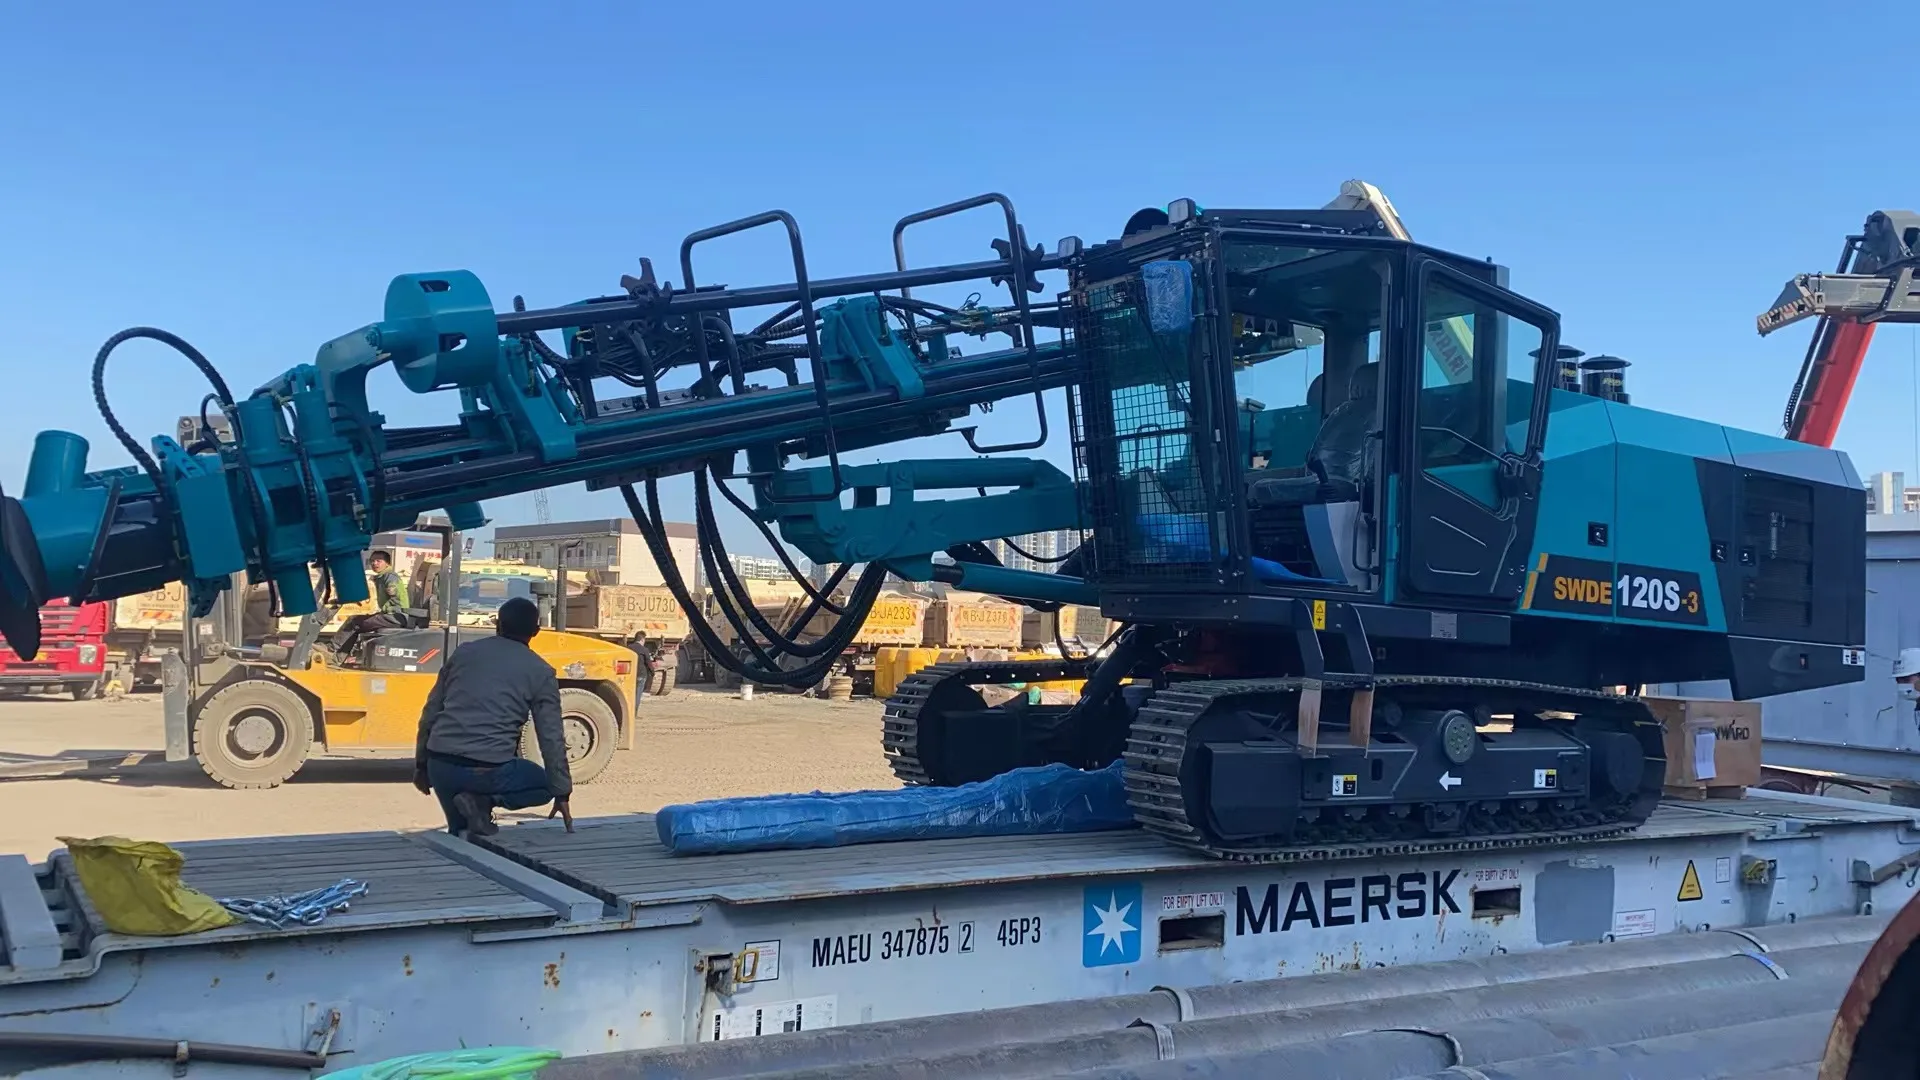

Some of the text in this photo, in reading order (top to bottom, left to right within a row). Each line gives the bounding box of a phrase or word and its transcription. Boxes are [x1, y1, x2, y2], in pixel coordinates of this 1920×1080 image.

[1554, 576, 1612, 605] SWDE
[1164, 893, 1224, 909] FOR EMPTY LIFT ONLY
[1236, 868, 1461, 936] MAERSK
[812, 933, 872, 967] MAEU
[881, 926, 949, 960] 347875
[961, 923, 972, 951] 2
[997, 916, 1041, 947] 45P3
